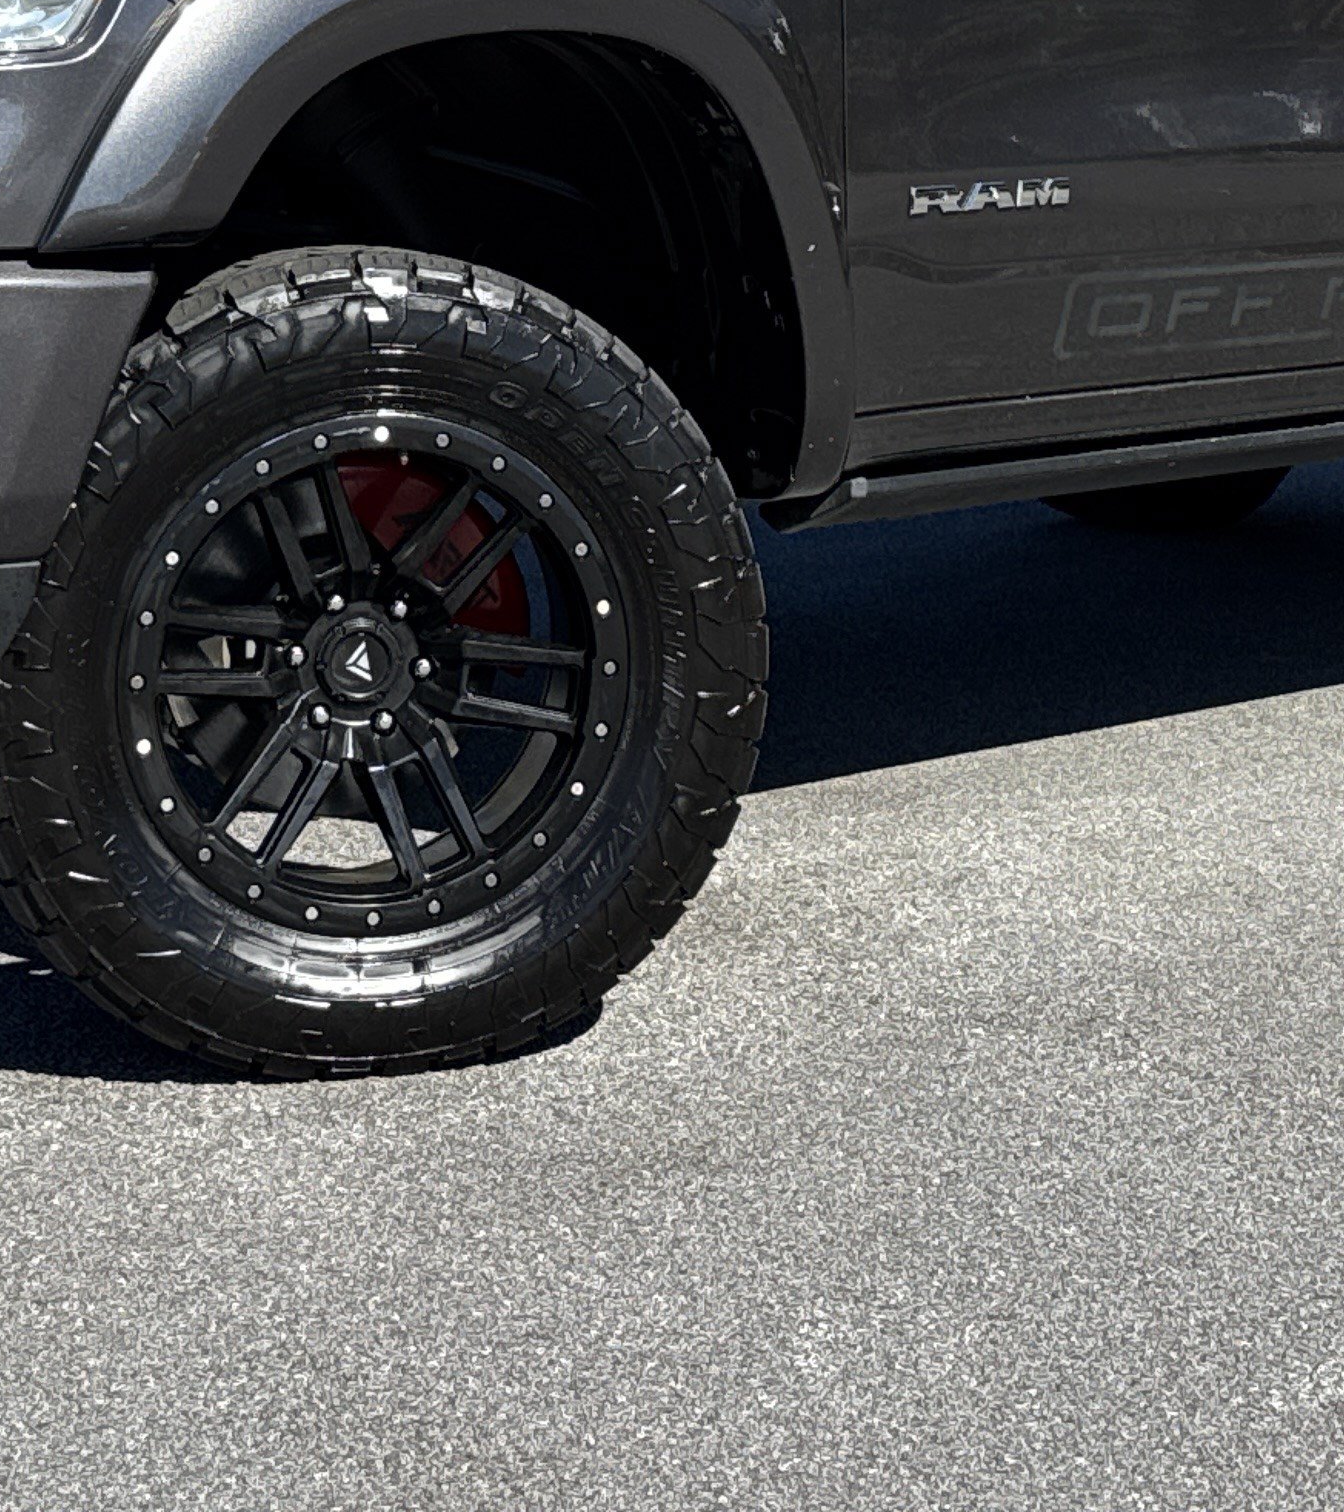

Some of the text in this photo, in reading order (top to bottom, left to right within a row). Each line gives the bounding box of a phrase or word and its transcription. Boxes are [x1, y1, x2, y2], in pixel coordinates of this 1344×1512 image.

[910, 177, 1070, 215] RAM
[1088, 284, 1278, 336] OFF
[489, 381, 627, 486] OPEN
